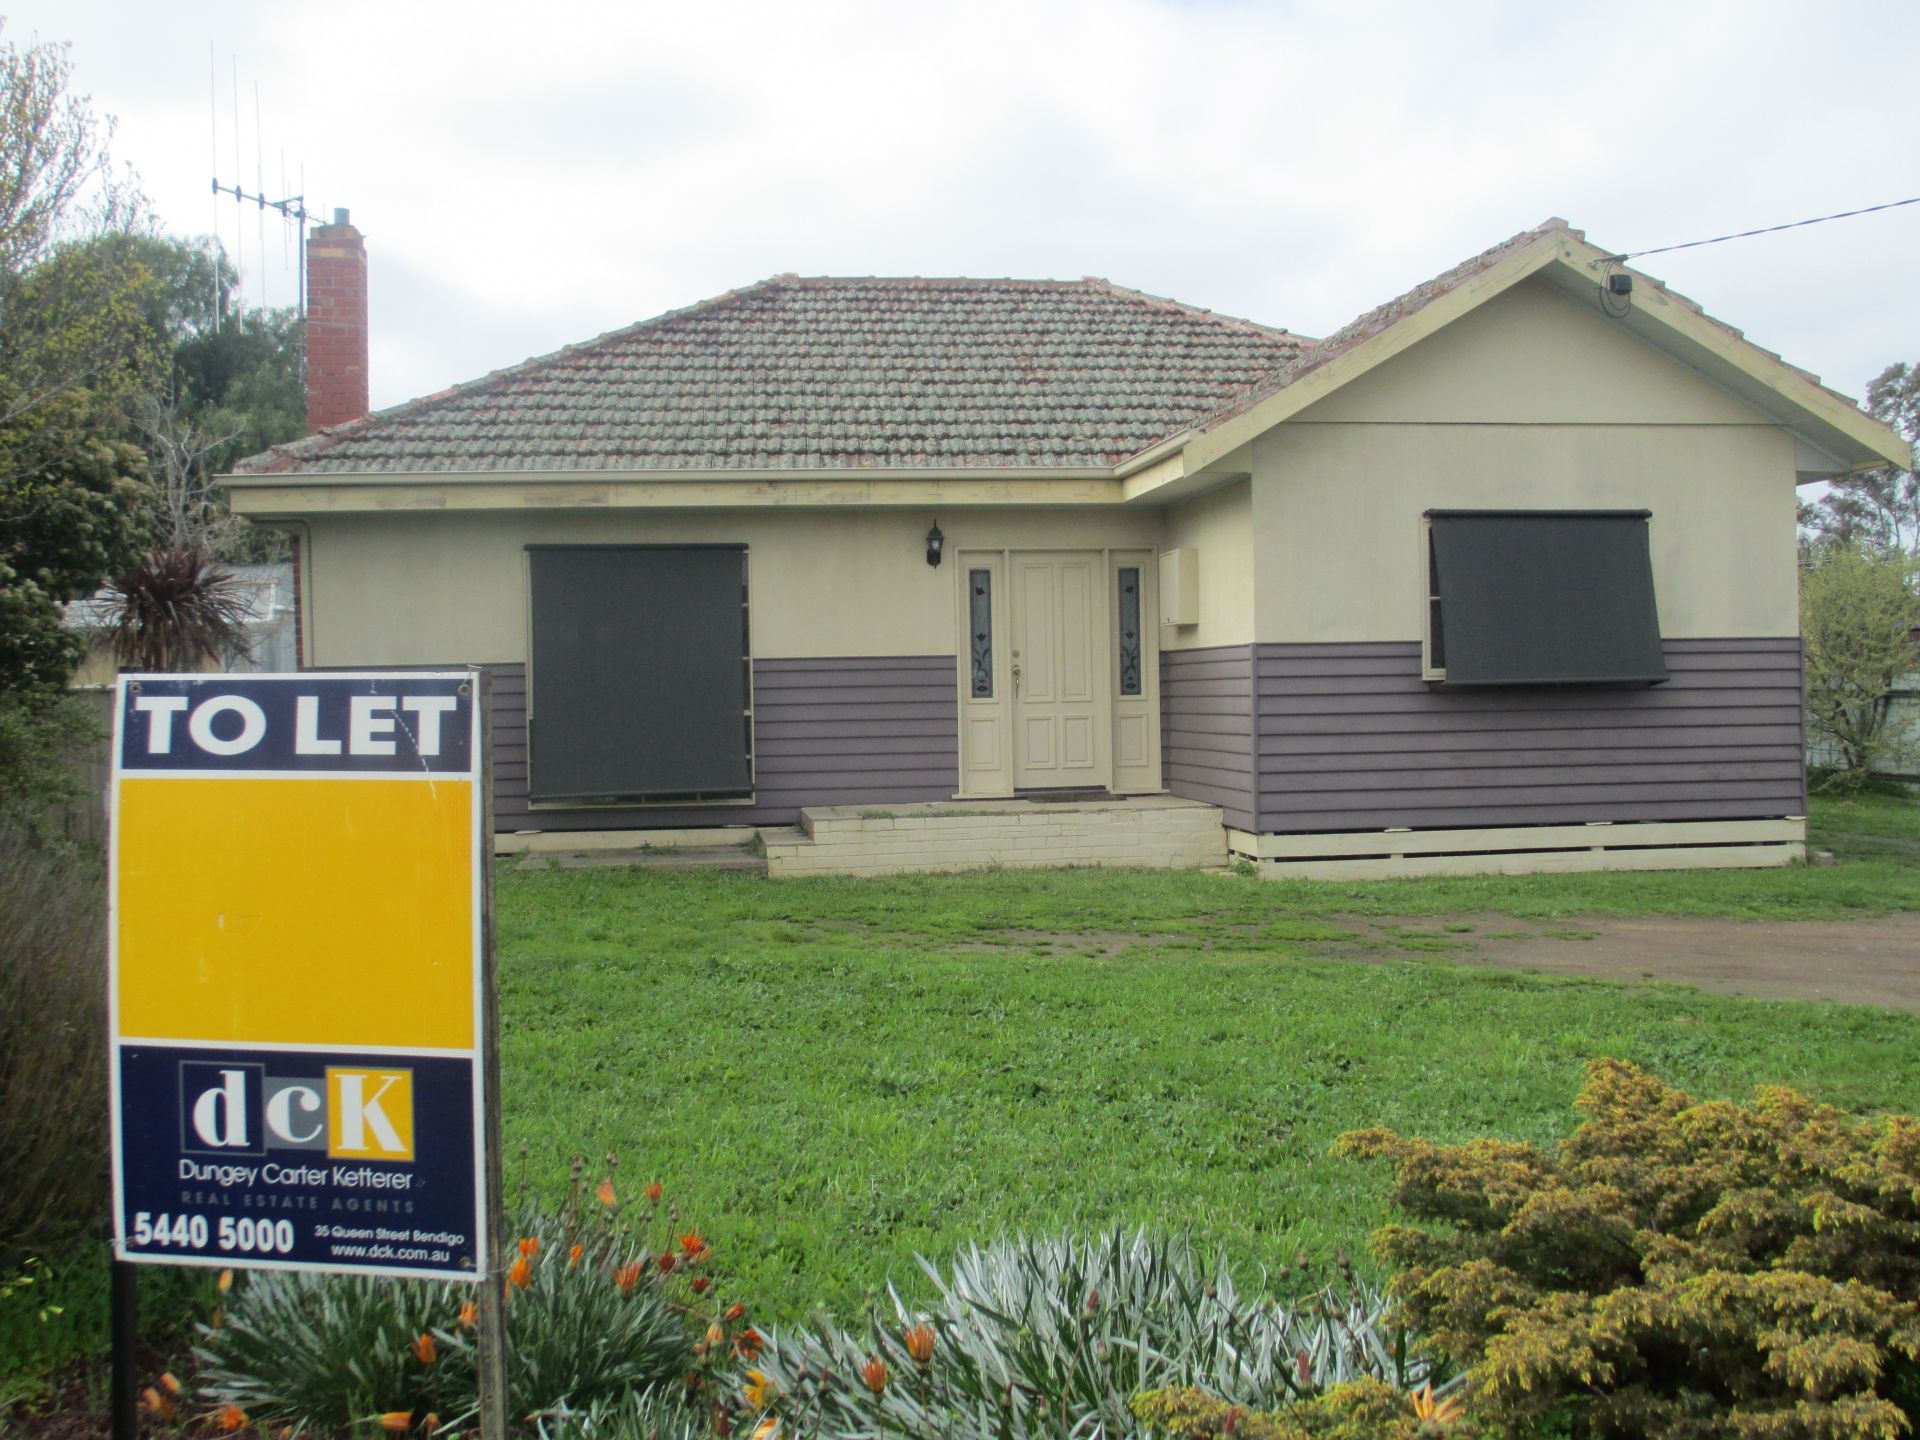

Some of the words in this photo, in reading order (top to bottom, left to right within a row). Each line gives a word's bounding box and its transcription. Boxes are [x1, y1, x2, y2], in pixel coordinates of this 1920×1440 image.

[134, 694, 267, 756] TO
[295, 695, 457, 756] LET
[178, 1159, 256, 1187] Dungey
[262, 1163, 327, 1186] Carter
[332, 1166, 413, 1190] Ketterer
[181, 1190, 231, 1206] REAL
[243, 1193, 318, 1211] ESTATE
[330, 1197, 415, 1214] AGENTS
[134, 1211, 208, 1249] 5440
[218, 1216, 294, 1253] 5000
[331, 1225, 373, 1240] Queen
[375, 1227, 410, 1242] Street
[412, 1229, 465, 1246] Bendigo
[330, 1242, 450, 1264] www.dck.com.au
